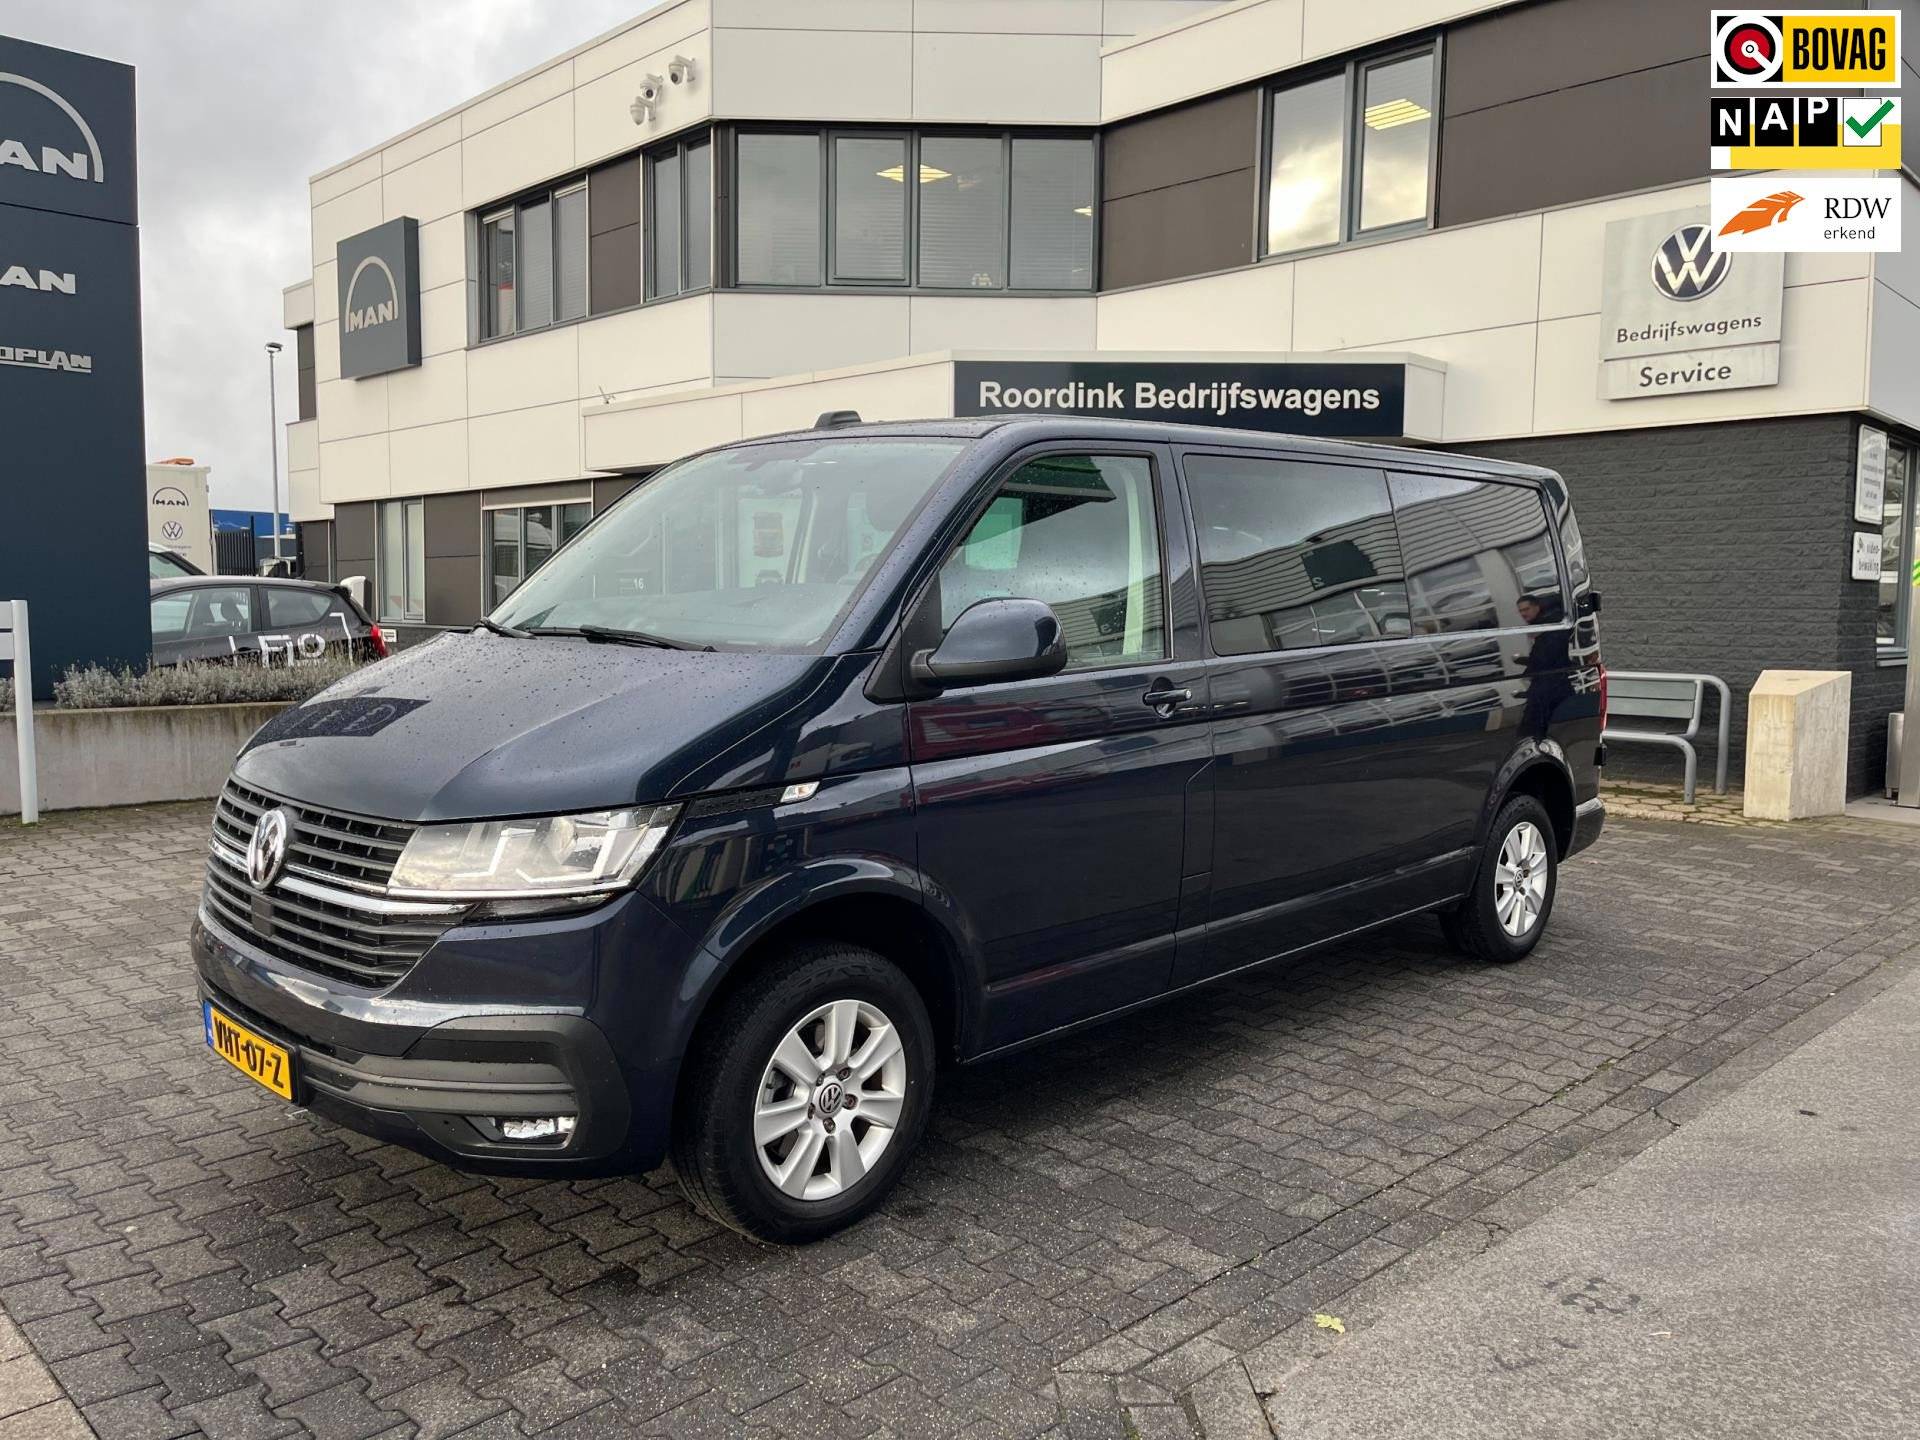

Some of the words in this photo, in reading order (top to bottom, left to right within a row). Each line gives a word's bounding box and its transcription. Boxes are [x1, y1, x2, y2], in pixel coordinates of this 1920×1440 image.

[349, 300, 393, 332] MAN
[1617, 316, 1761, 343] Bedrijfswagens
[1639, 362, 1732, 387] Service
[979, 381, 1125, 409] Roordink
[1135, 381, 1380, 416] Bedrijfswagens
[213, 1015, 285, 1089] VHT-07-Z
